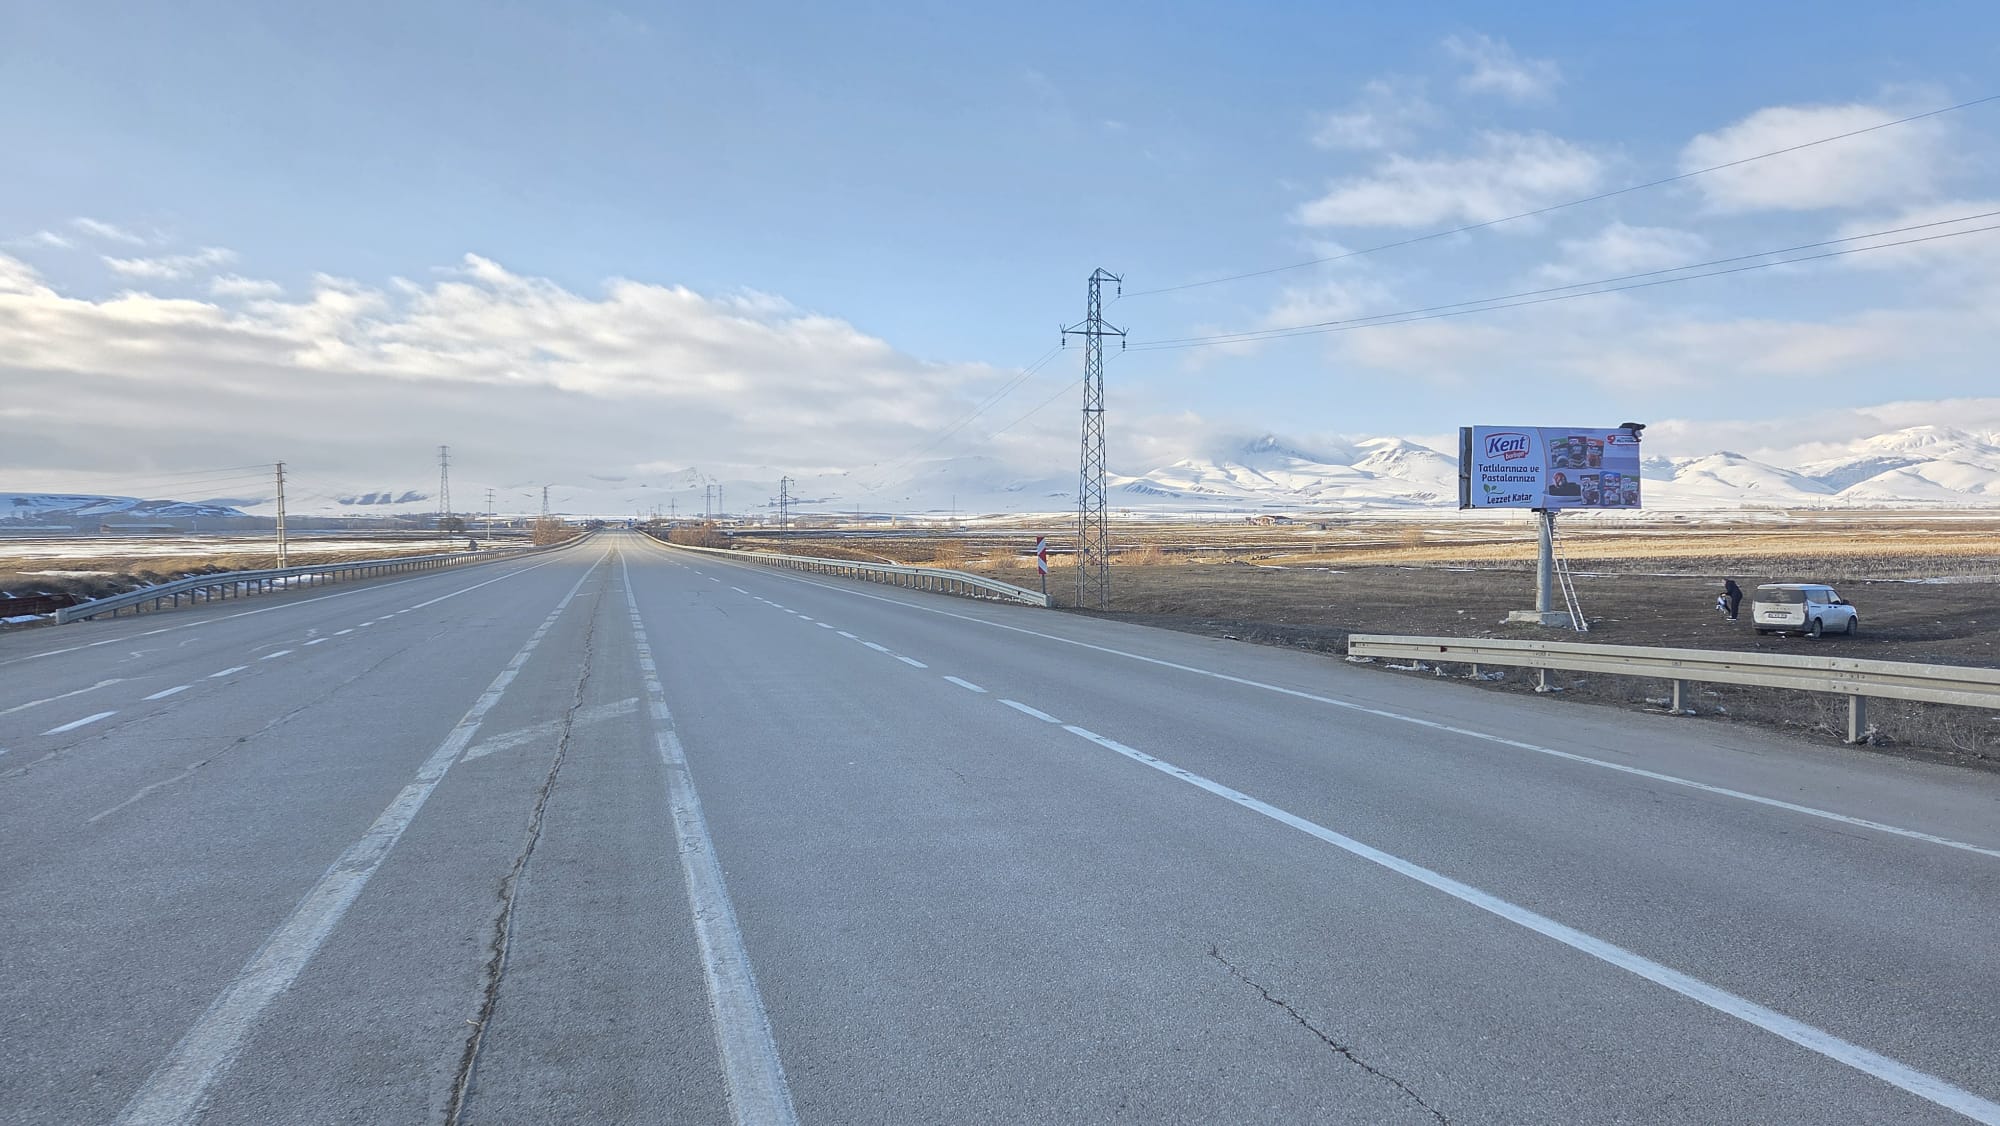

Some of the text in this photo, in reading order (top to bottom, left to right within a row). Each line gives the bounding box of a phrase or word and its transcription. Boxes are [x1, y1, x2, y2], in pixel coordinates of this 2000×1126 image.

[1489, 437, 1526, 453] Kent
[1482, 474, 1535, 482] Pastalarınıza
[1487, 493, 1533, 504] Lezzet Katar
